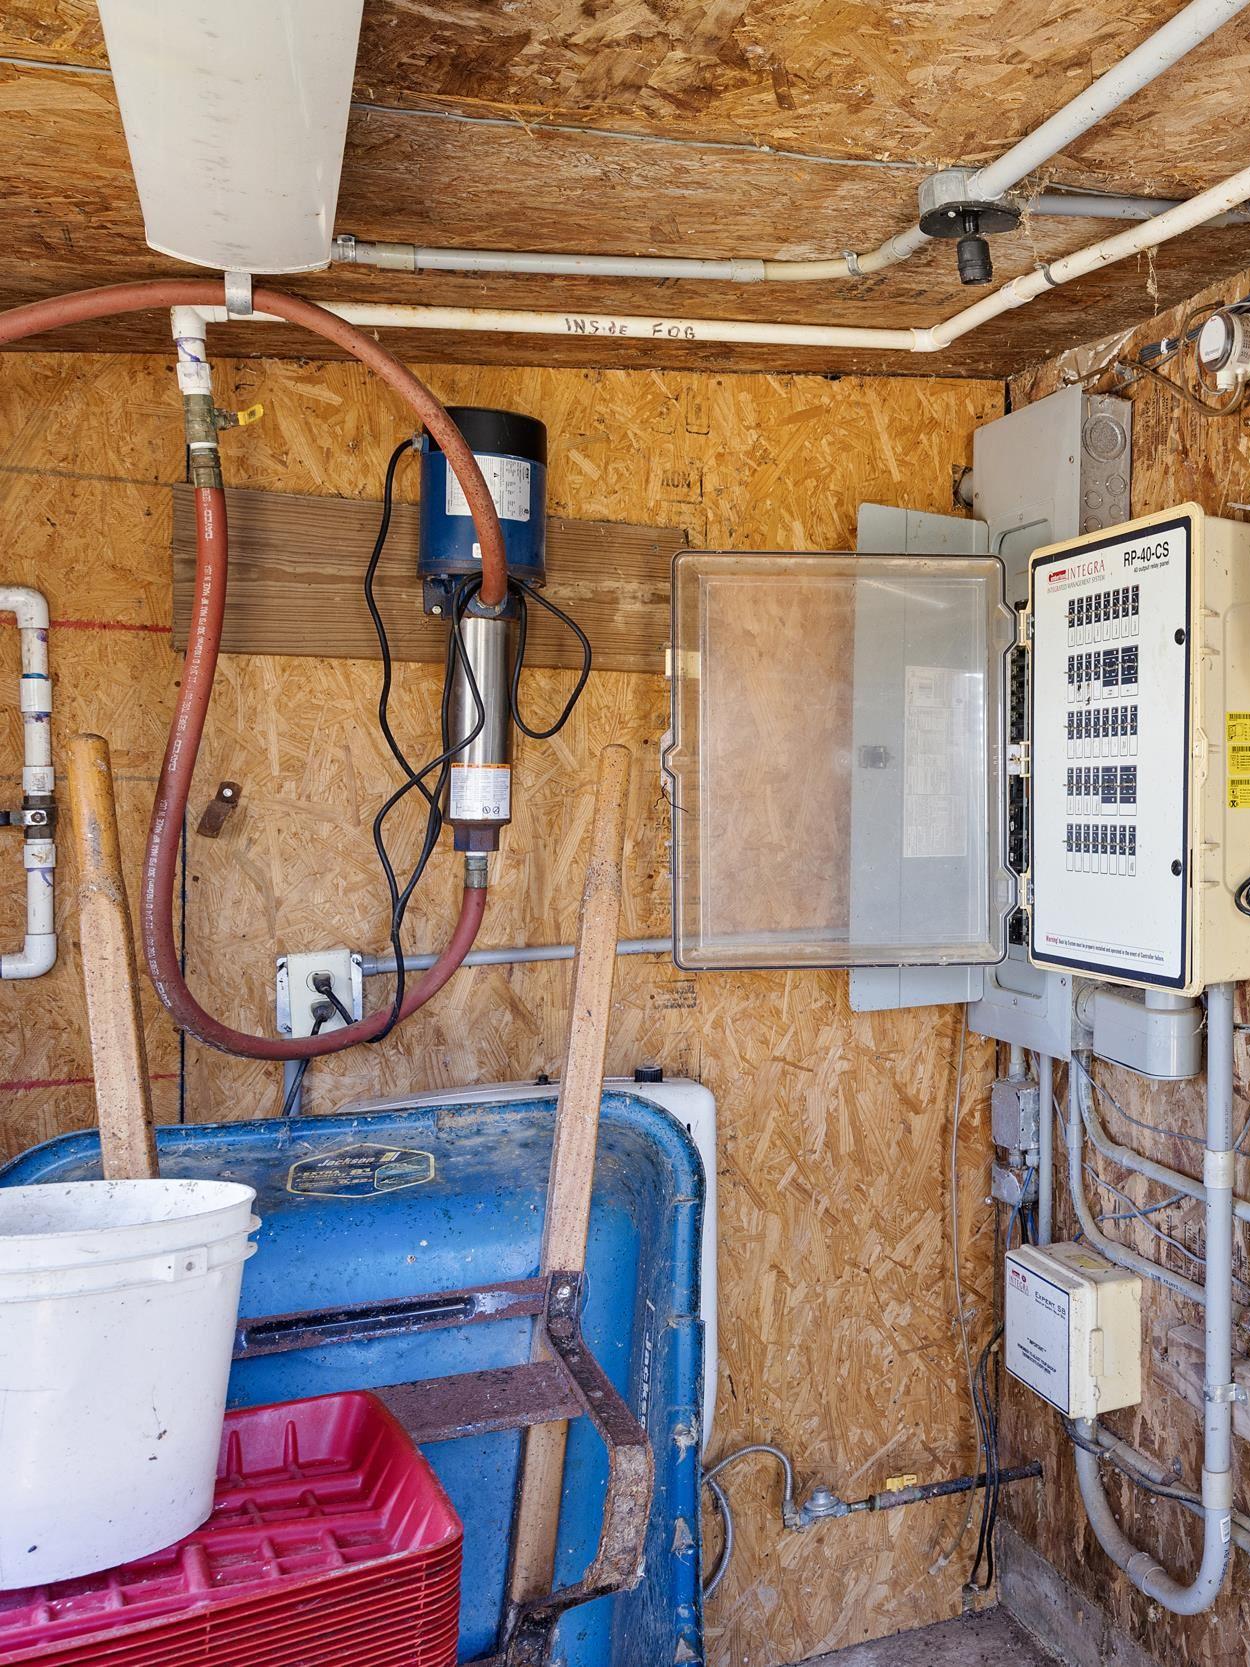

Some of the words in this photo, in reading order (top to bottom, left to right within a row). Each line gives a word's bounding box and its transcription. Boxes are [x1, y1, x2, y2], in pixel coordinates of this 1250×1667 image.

[652, 322, 696, 339] FOG
[204, 509, 213, 540] DAYCO
[1124, 542, 1170, 567] RP-40-CS
[1067, 560, 1105, 580] INTEGRA
[168, 739, 182, 772] DAYCO
[177, 714, 188, 732] SERIES
[202, 582, 211, 596] MADE
[148, 858, 157, 866] PSI
[154, 818, 164, 833] MADE
[1046, 935, 1060, 944] Warning!
[318, 1157, 376, 1166] Jackson
[641, 1332, 652, 1430] Jackso
